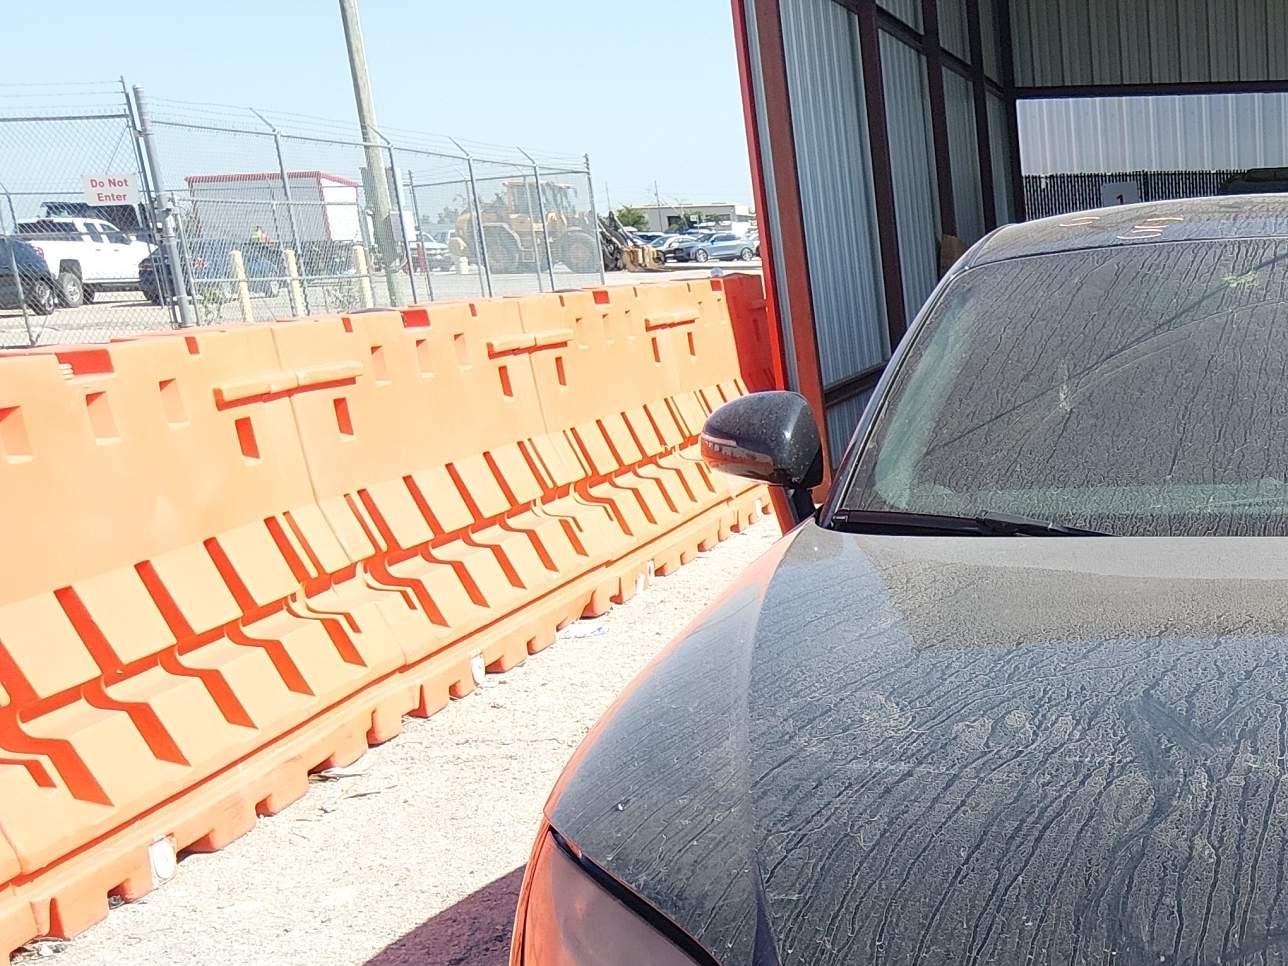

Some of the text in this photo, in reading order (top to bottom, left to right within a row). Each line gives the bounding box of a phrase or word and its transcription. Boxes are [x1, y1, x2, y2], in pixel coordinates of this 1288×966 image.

[90, 179, 128, 188] Do Not
[97, 192, 127, 202] Enter
